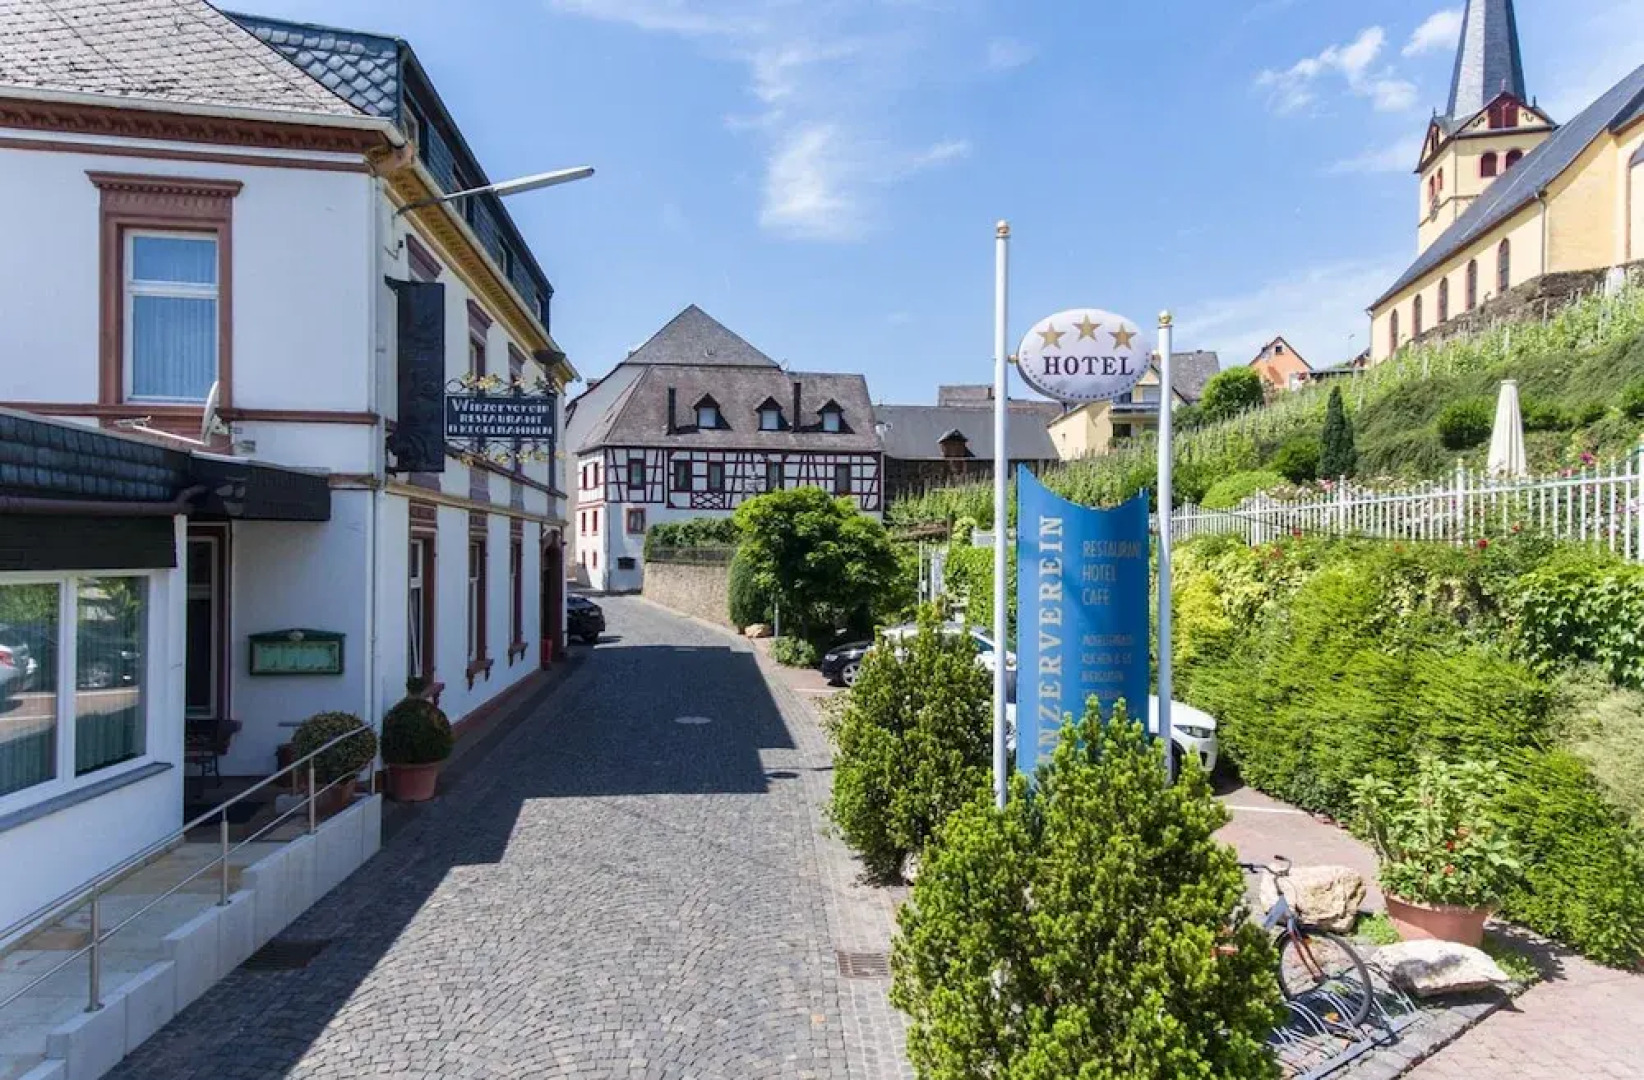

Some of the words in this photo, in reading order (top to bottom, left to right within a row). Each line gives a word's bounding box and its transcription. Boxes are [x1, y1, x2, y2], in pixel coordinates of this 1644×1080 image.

[1043, 356, 1134, 376] HOTEL
[452, 398, 550, 413] Winzerverein
[460, 413, 542, 424] RESTAURANT
[1082, 564, 1117, 582] HOTEL
